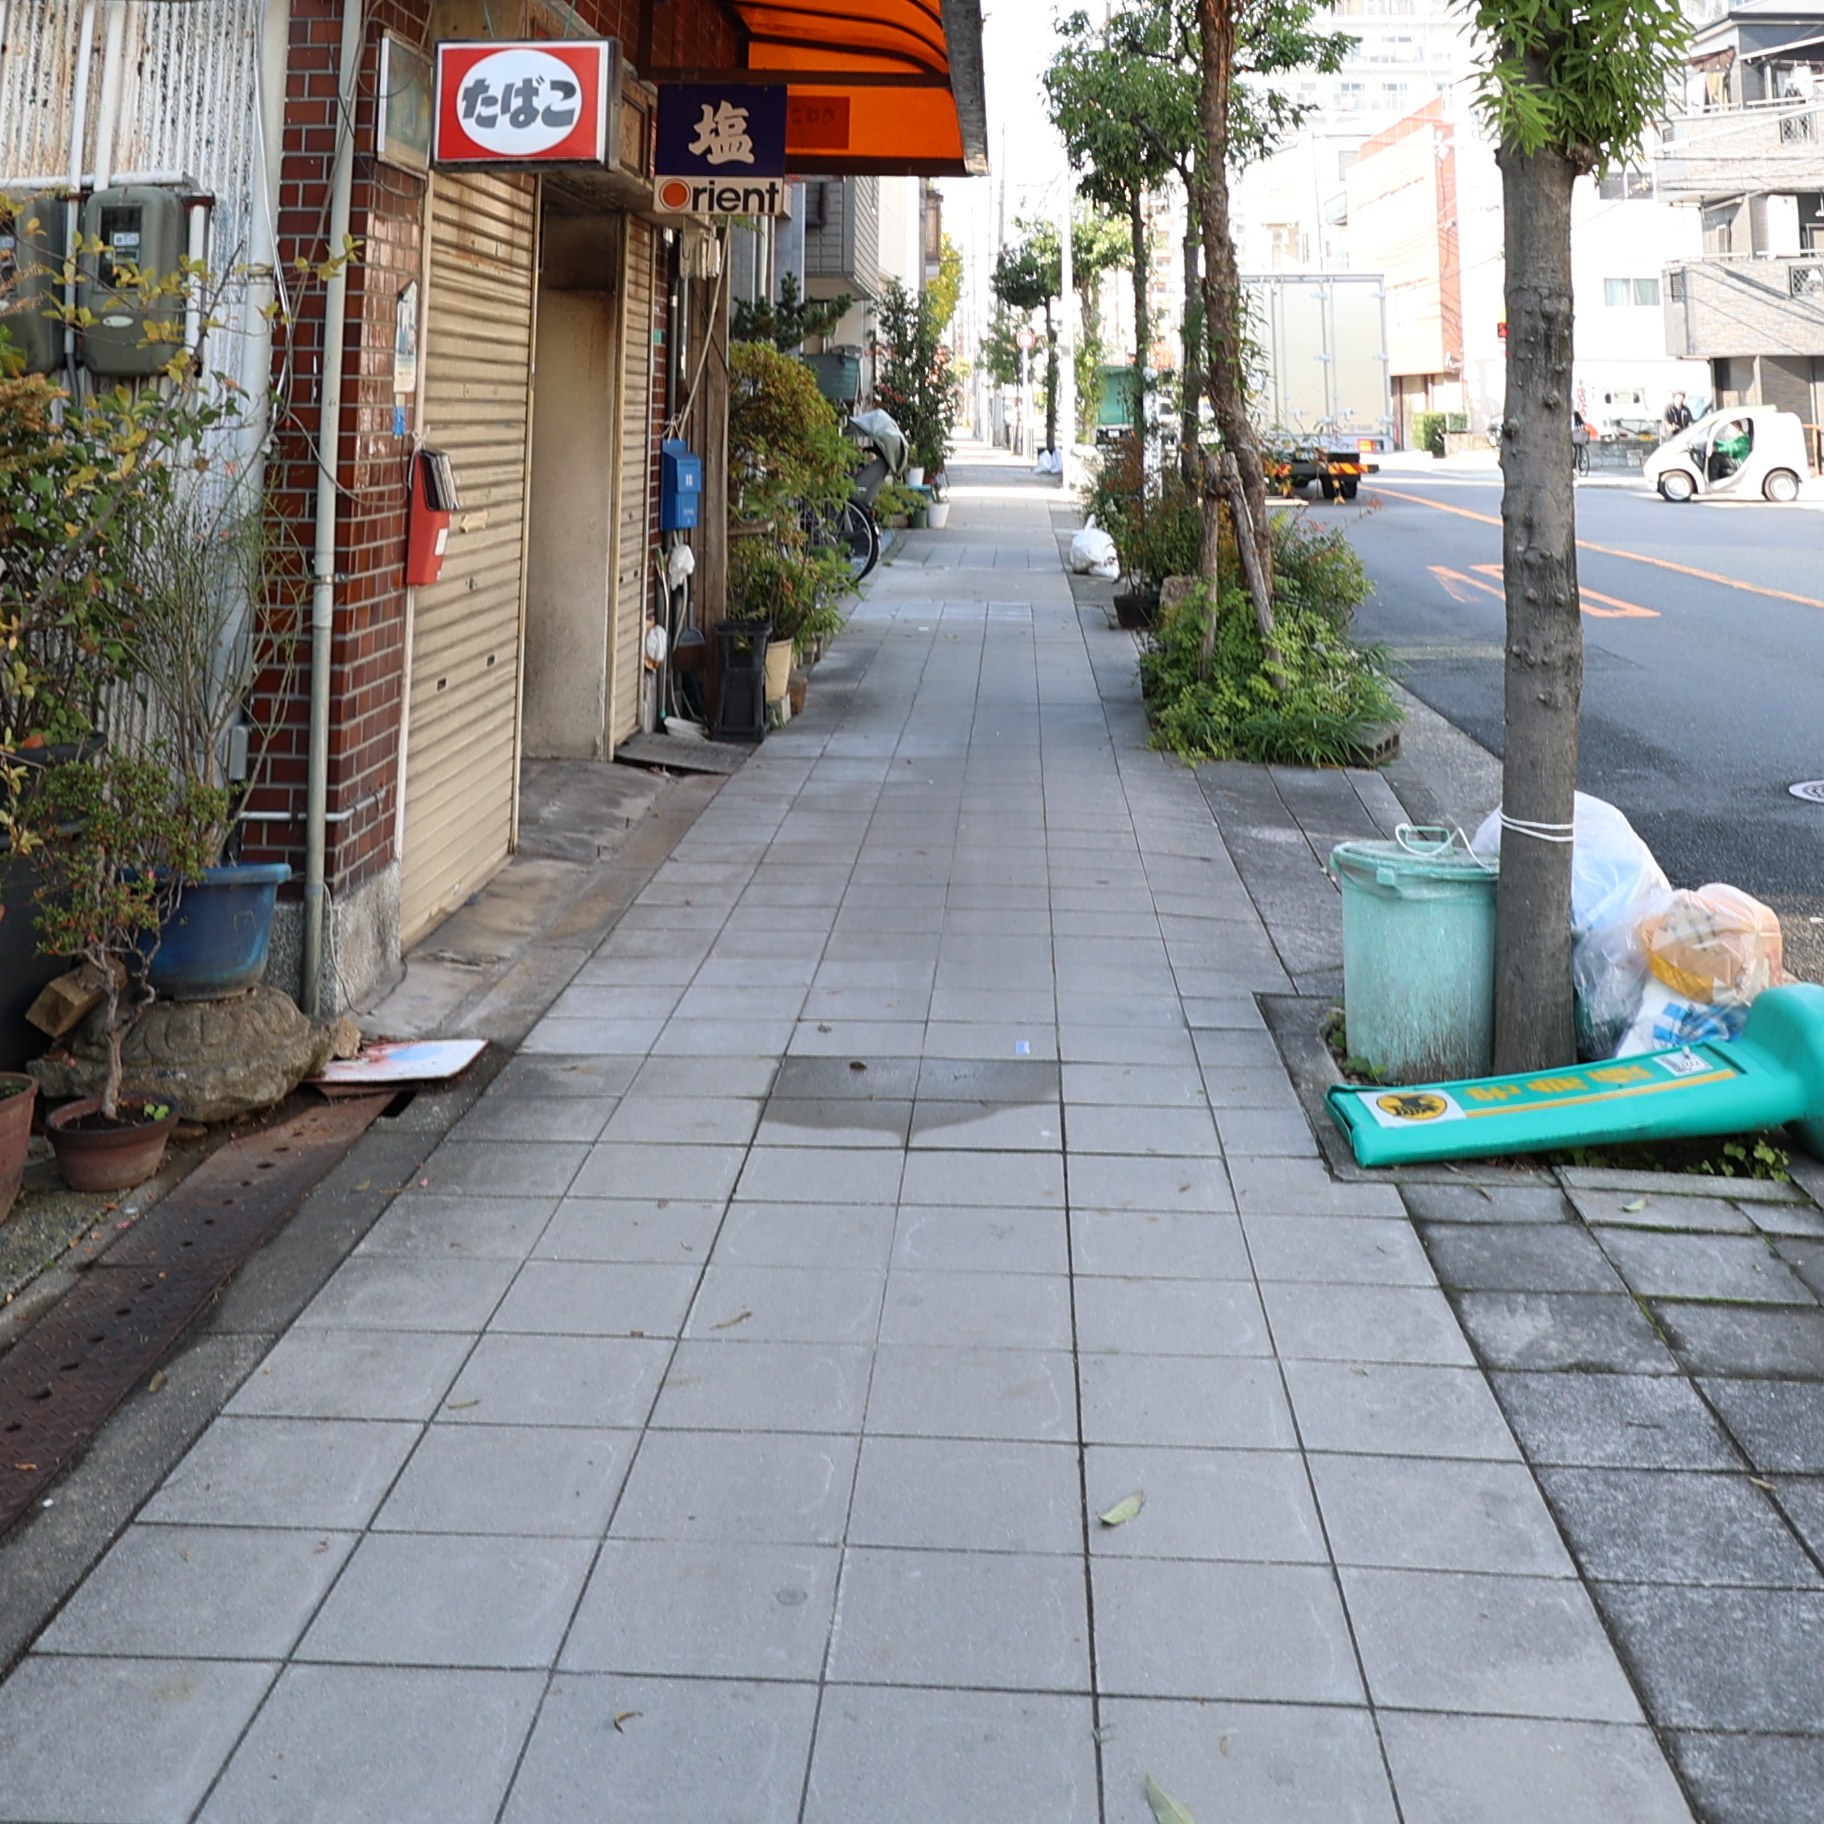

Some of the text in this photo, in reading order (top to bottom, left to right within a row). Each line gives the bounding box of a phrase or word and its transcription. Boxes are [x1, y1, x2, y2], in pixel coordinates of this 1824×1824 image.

[461, 75, 577, 129] たばこ
[688, 100, 755, 165] 塩
[659, 178, 780, 213] Orient
